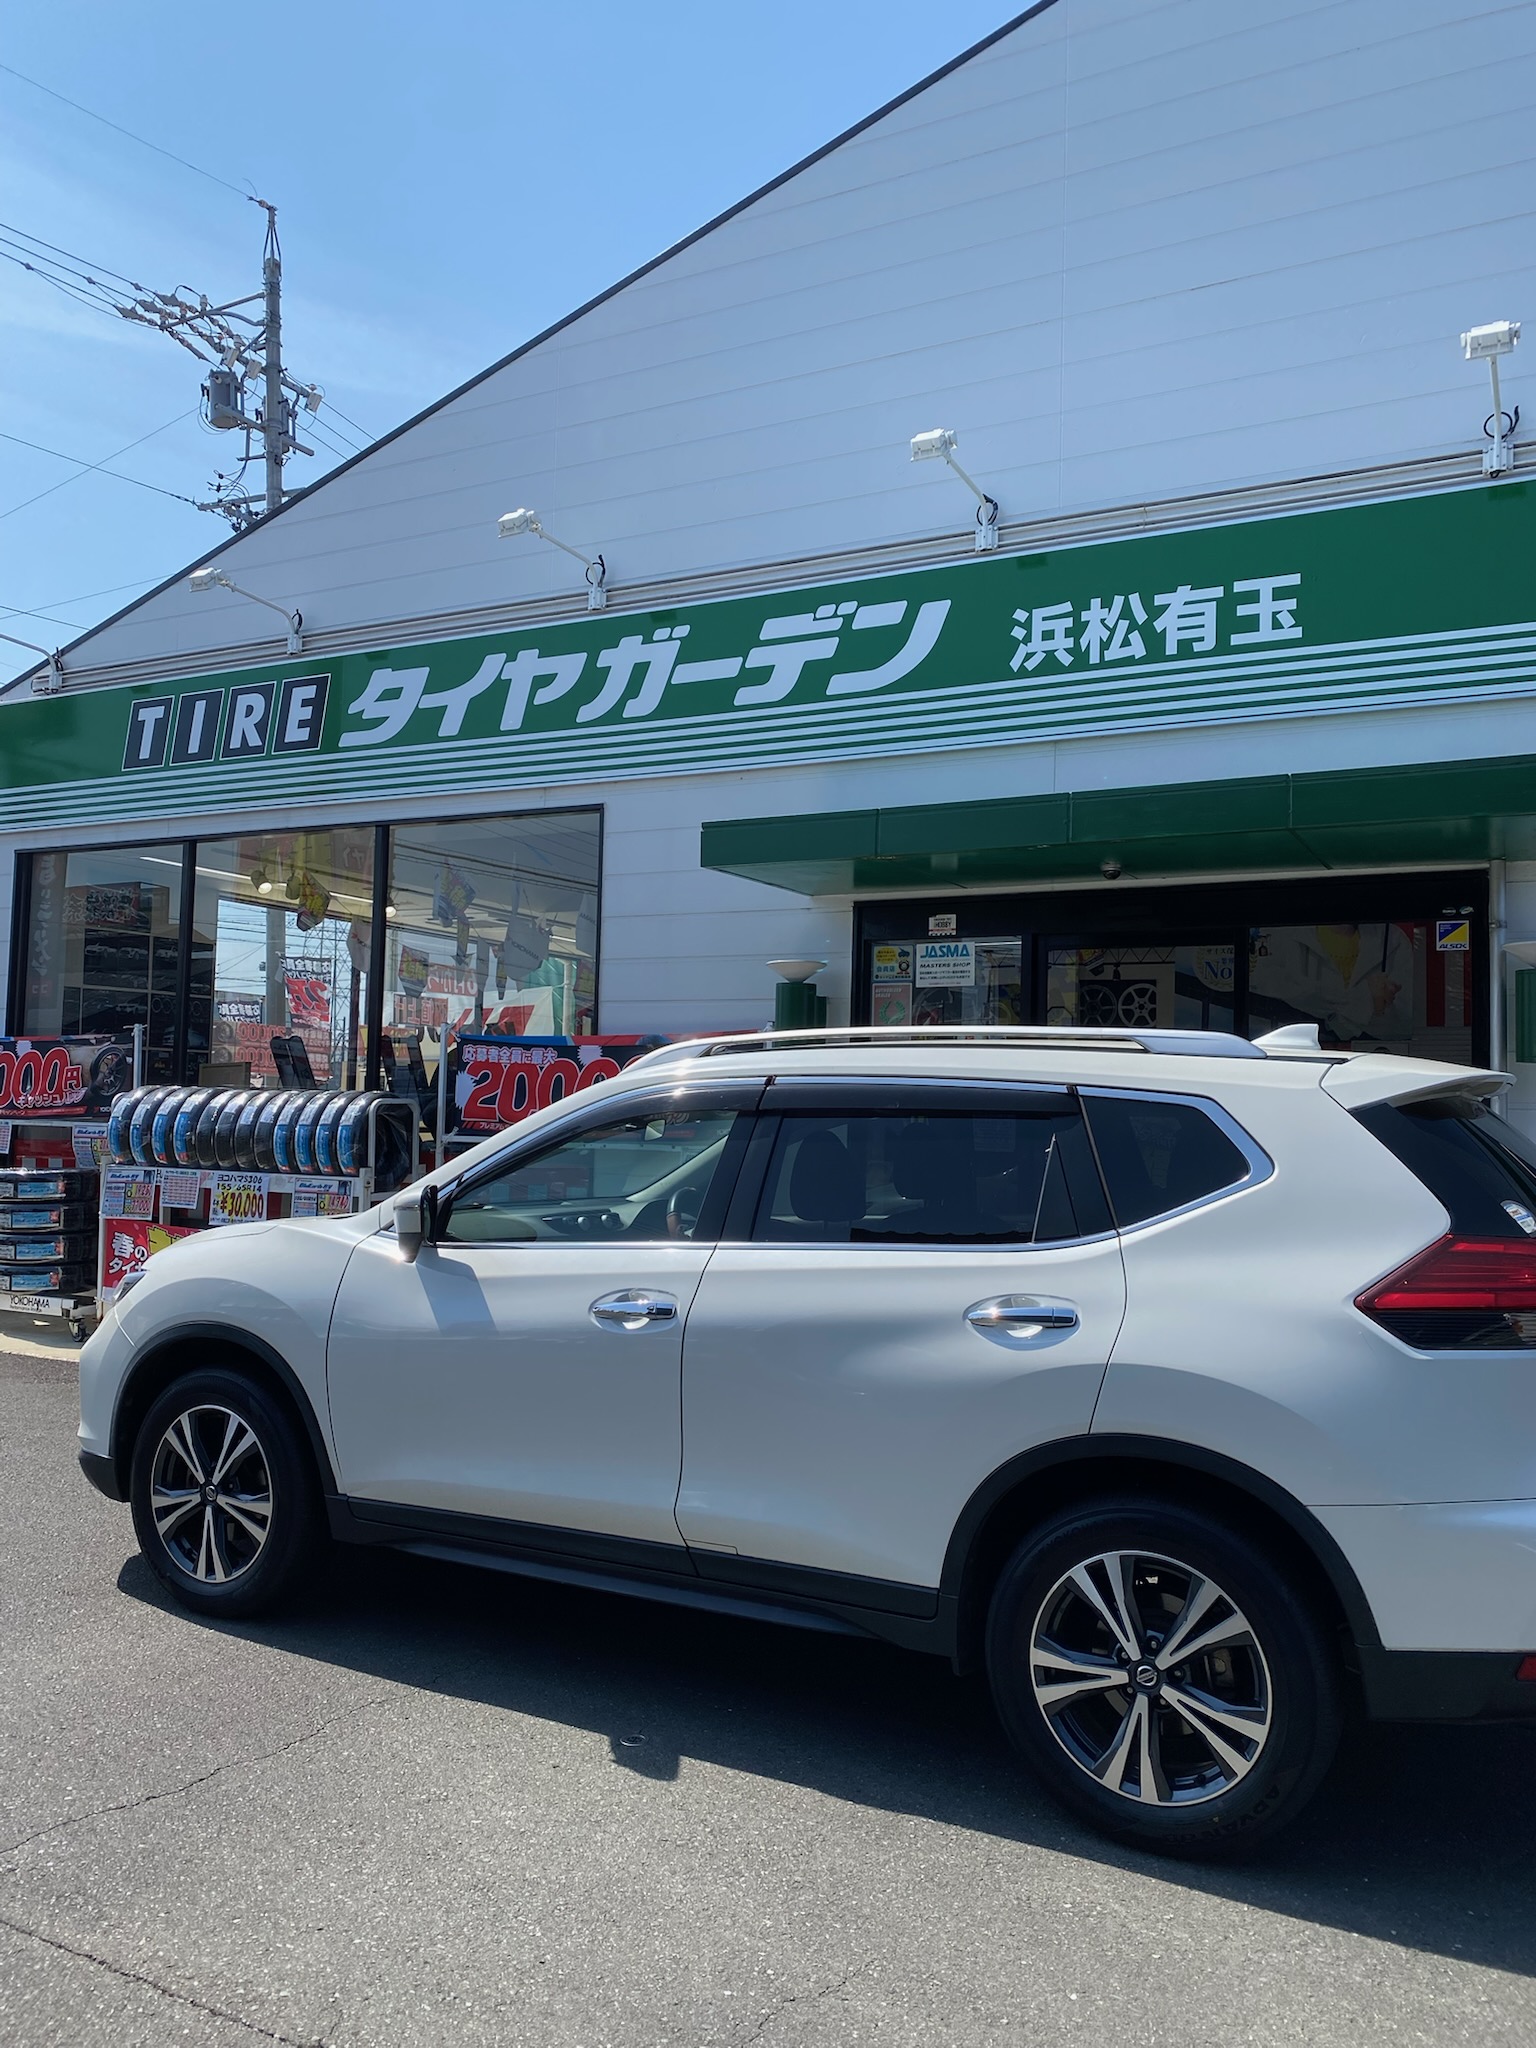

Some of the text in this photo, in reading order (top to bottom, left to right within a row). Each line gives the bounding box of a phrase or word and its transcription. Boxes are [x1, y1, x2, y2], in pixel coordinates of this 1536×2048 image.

[135, 573, 1303, 761] TIRE タイヤガーデン 浜松有玉
[920, 944, 970, 958] JASMA
[462, 1044, 558, 1065] 応募者全員に最大
[217, 1174, 263, 1184] ヨコハマS306
[112, 1232, 148, 1262] 春の
[10, 1295, 50, 1308] YOKOHAMA
